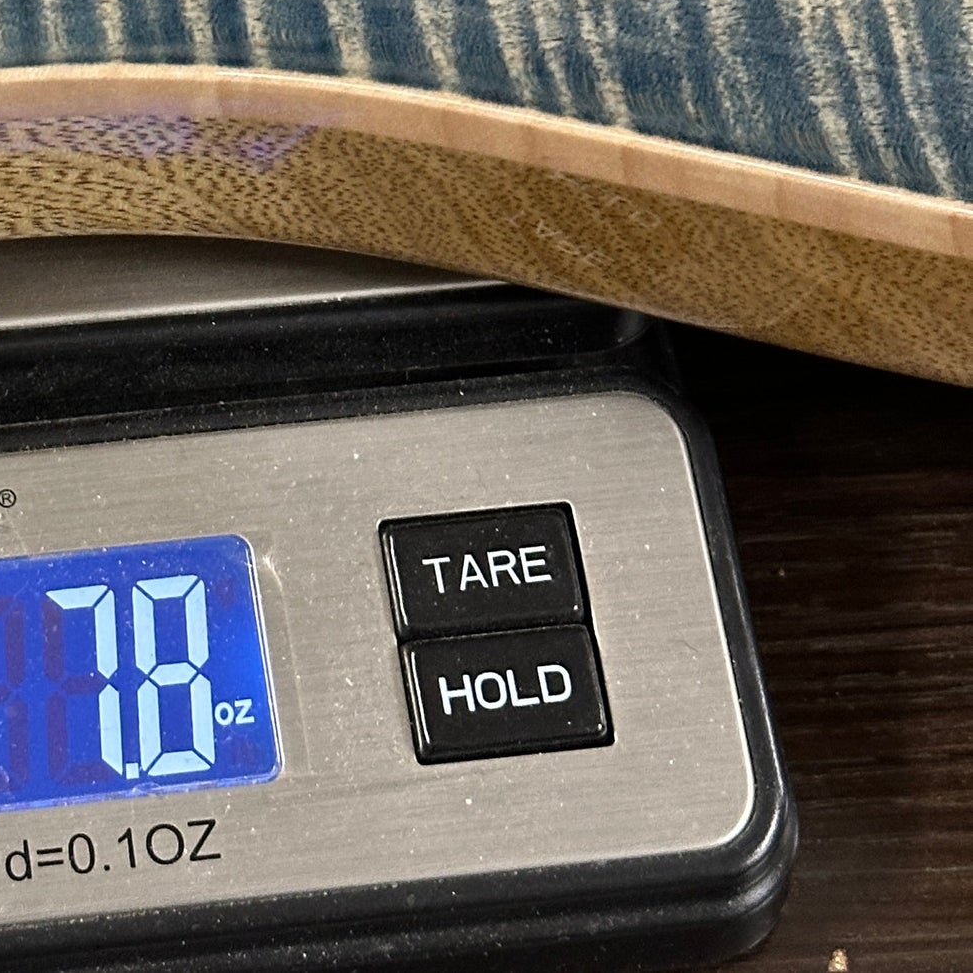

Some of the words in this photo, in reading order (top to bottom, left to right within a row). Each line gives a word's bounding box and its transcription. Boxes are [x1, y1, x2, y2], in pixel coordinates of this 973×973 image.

[422, 545, 553, 594] TARE
[214, 698, 256, 726] oz
[438, 664, 572, 716] HOLD
